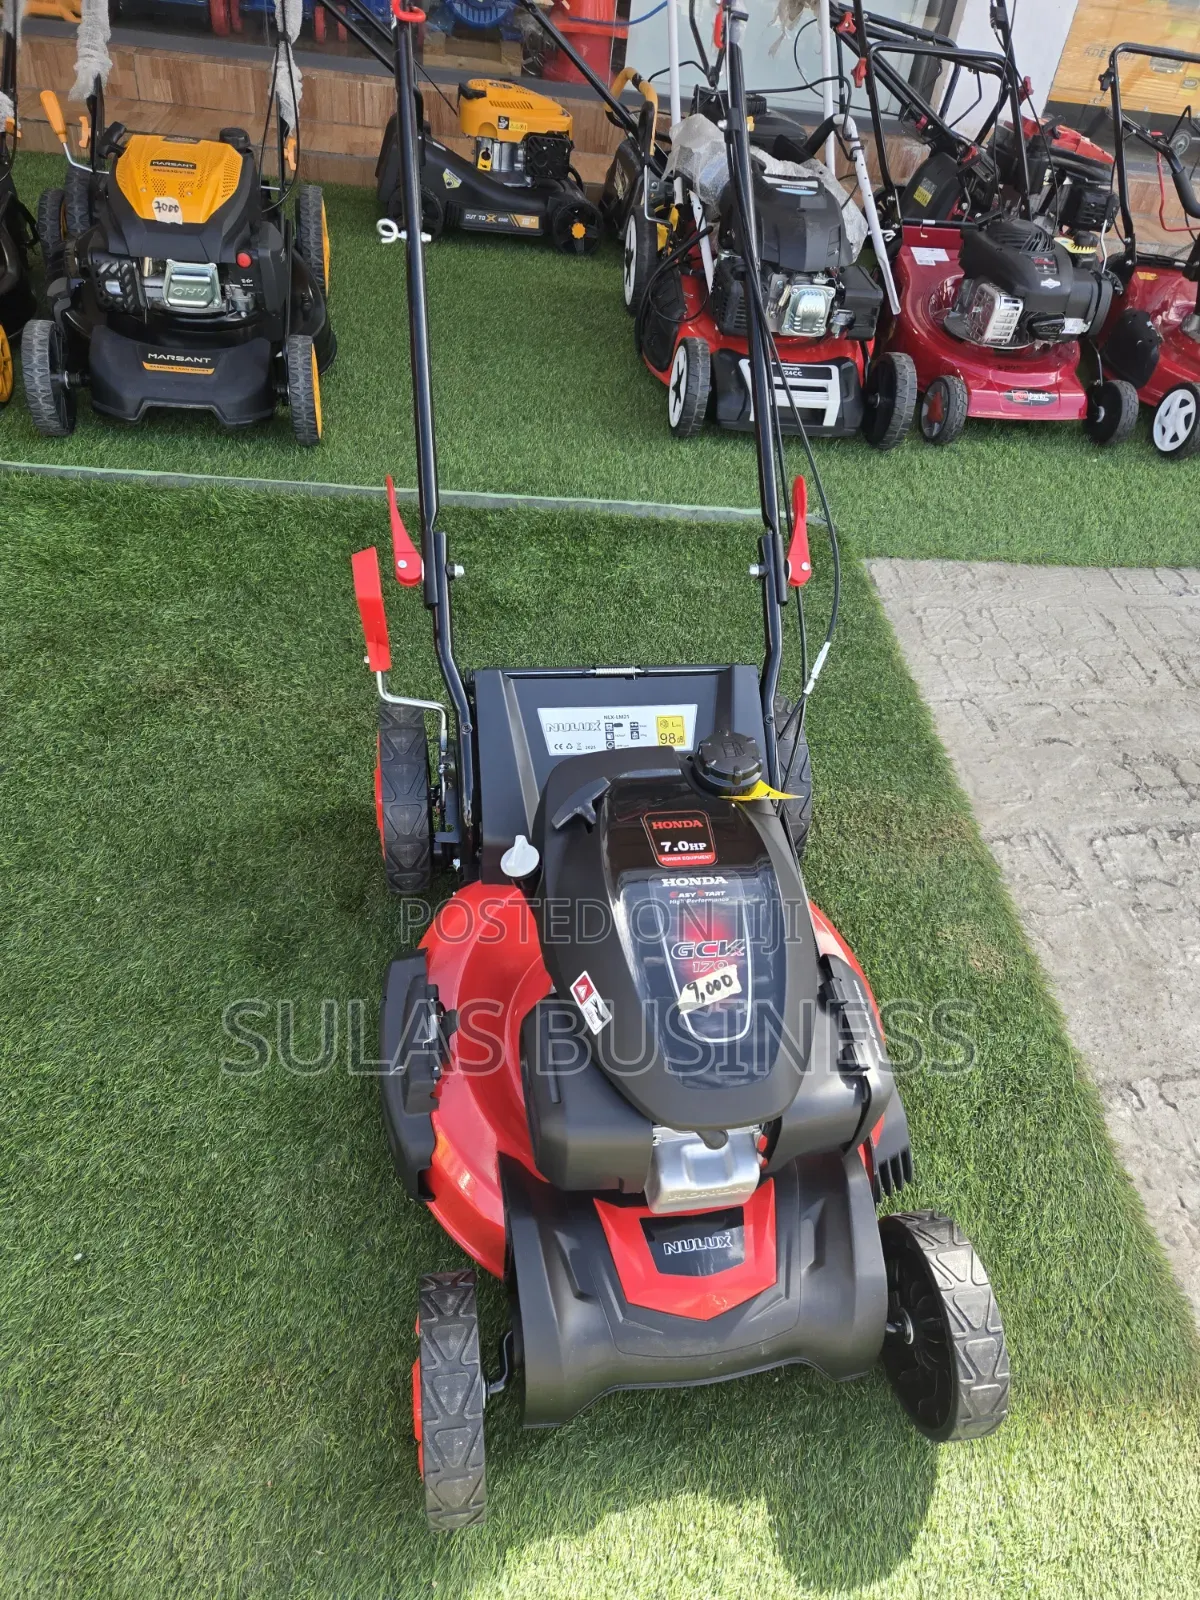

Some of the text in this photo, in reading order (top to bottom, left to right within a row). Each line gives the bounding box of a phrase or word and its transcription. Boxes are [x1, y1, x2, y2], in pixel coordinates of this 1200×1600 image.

[154, 201, 180, 213] 7000
[148, 353, 211, 363] MARSANT
[546, 720, 601, 732] NULUX
[660, 733, 676, 744] 98
[652, 820, 703, 829] HONDA
[661, 841, 707, 852] 7.0HP
[661, 876, 728, 887] HONDA
[692, 960, 729, 973] 170
[686, 974, 733, 1003] 9,000
[663, 1235, 733, 1255] NULUX
